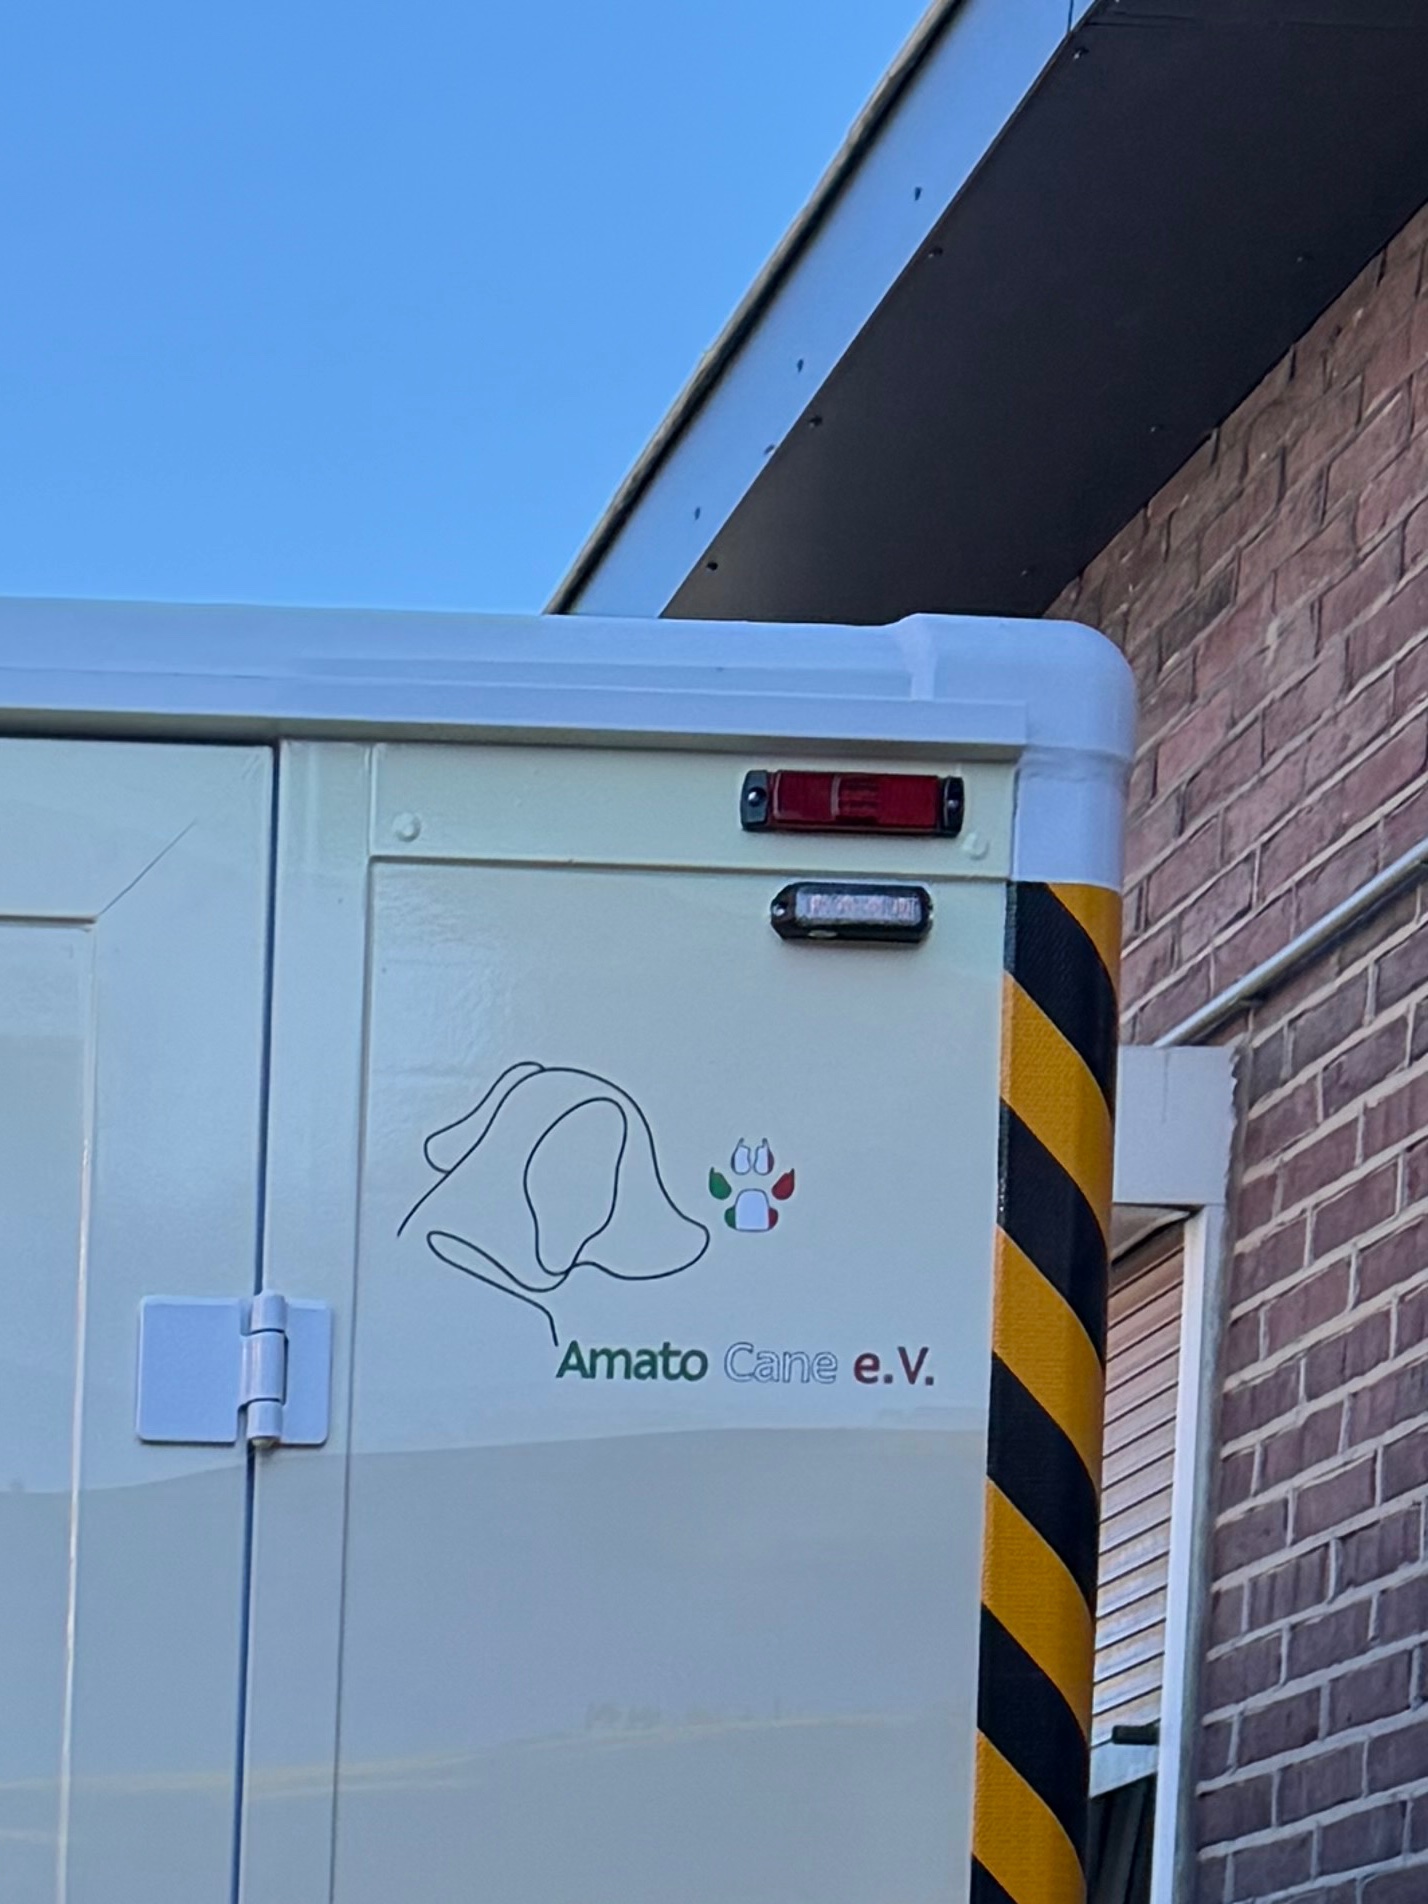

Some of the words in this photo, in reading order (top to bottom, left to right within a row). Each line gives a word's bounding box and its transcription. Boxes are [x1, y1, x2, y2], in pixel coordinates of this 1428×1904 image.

[555, 1340, 709, 1382] Amato
[723, 1342, 838, 1384] Cane
[852, 1345, 935, 1387] e.V.
